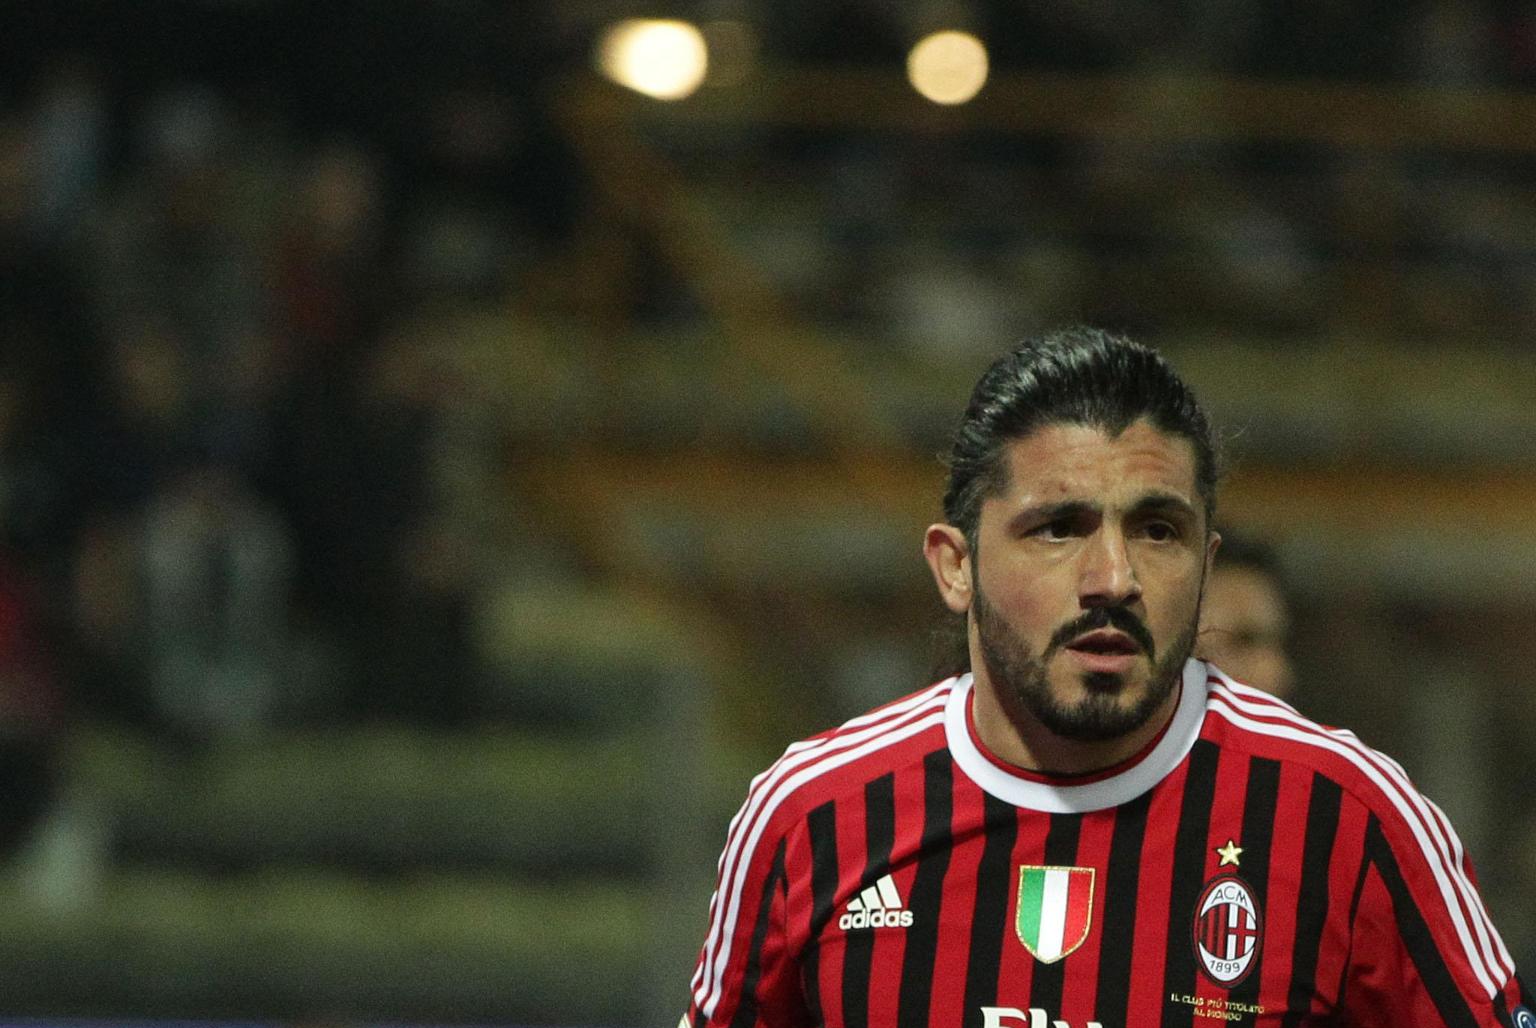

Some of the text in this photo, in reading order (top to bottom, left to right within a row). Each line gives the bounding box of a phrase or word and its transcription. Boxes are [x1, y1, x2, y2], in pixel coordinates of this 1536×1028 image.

[1211, 885, 1249, 907] ACM
[838, 906, 914, 931] adidas
[1208, 959, 1241, 974] 1899
